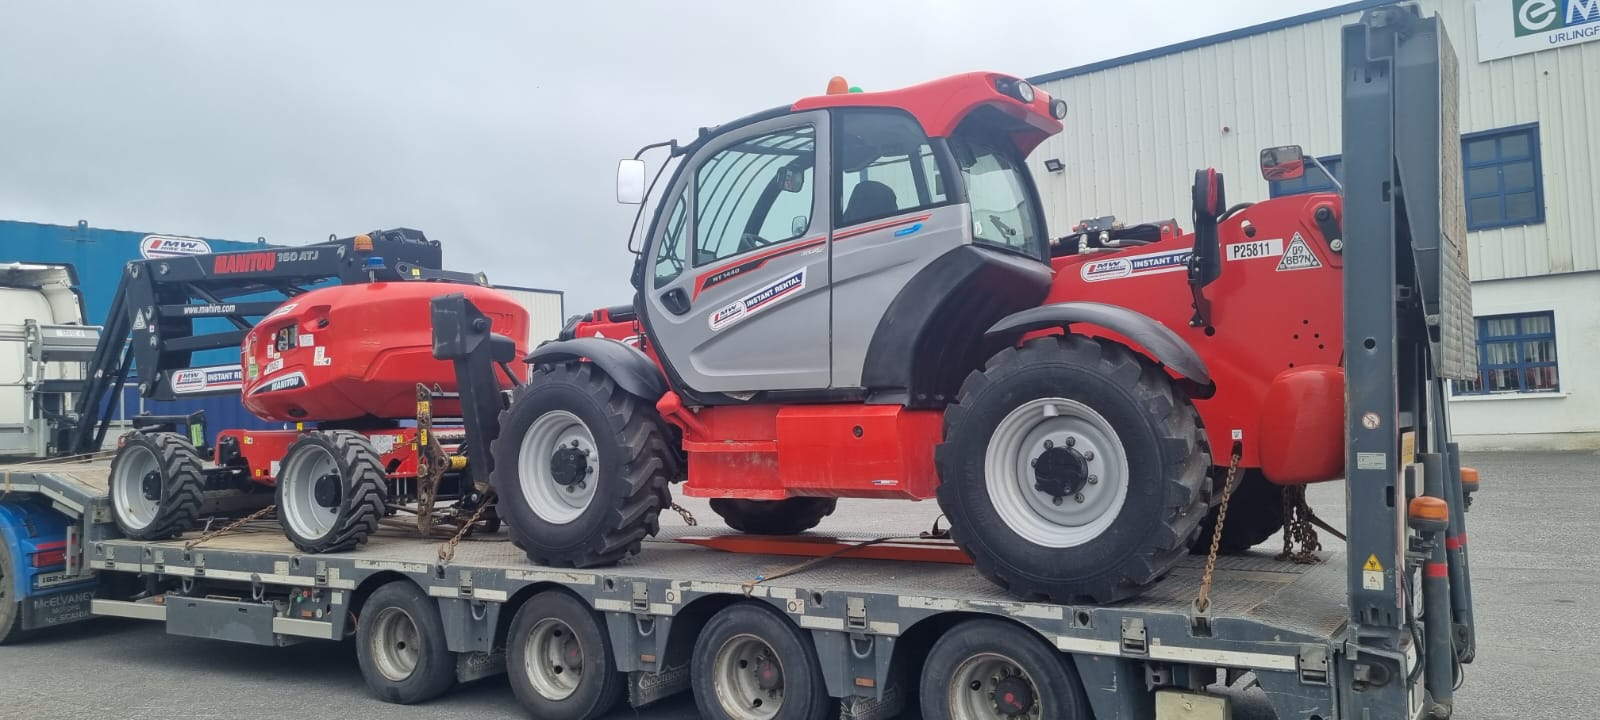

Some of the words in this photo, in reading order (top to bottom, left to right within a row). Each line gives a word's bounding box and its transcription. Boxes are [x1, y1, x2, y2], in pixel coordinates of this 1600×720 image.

[164, 240, 197, 248] MW
[1233, 242, 1270, 258] P25811
[214, 252, 276, 274] MANITOU
[277, 251, 298, 263] 160
[299, 250, 319, 261] ATJ
[1096, 261, 1121, 269] MW
[1134, 257, 1170, 268] INSTANT
[746, 290, 774, 308] INSTANT
[774, 277, 801, 294] RENTAL
[719, 304, 737, 317] MW
[207, 371, 233, 382] INSTANT
[271, 376, 300, 391] MANITOU
